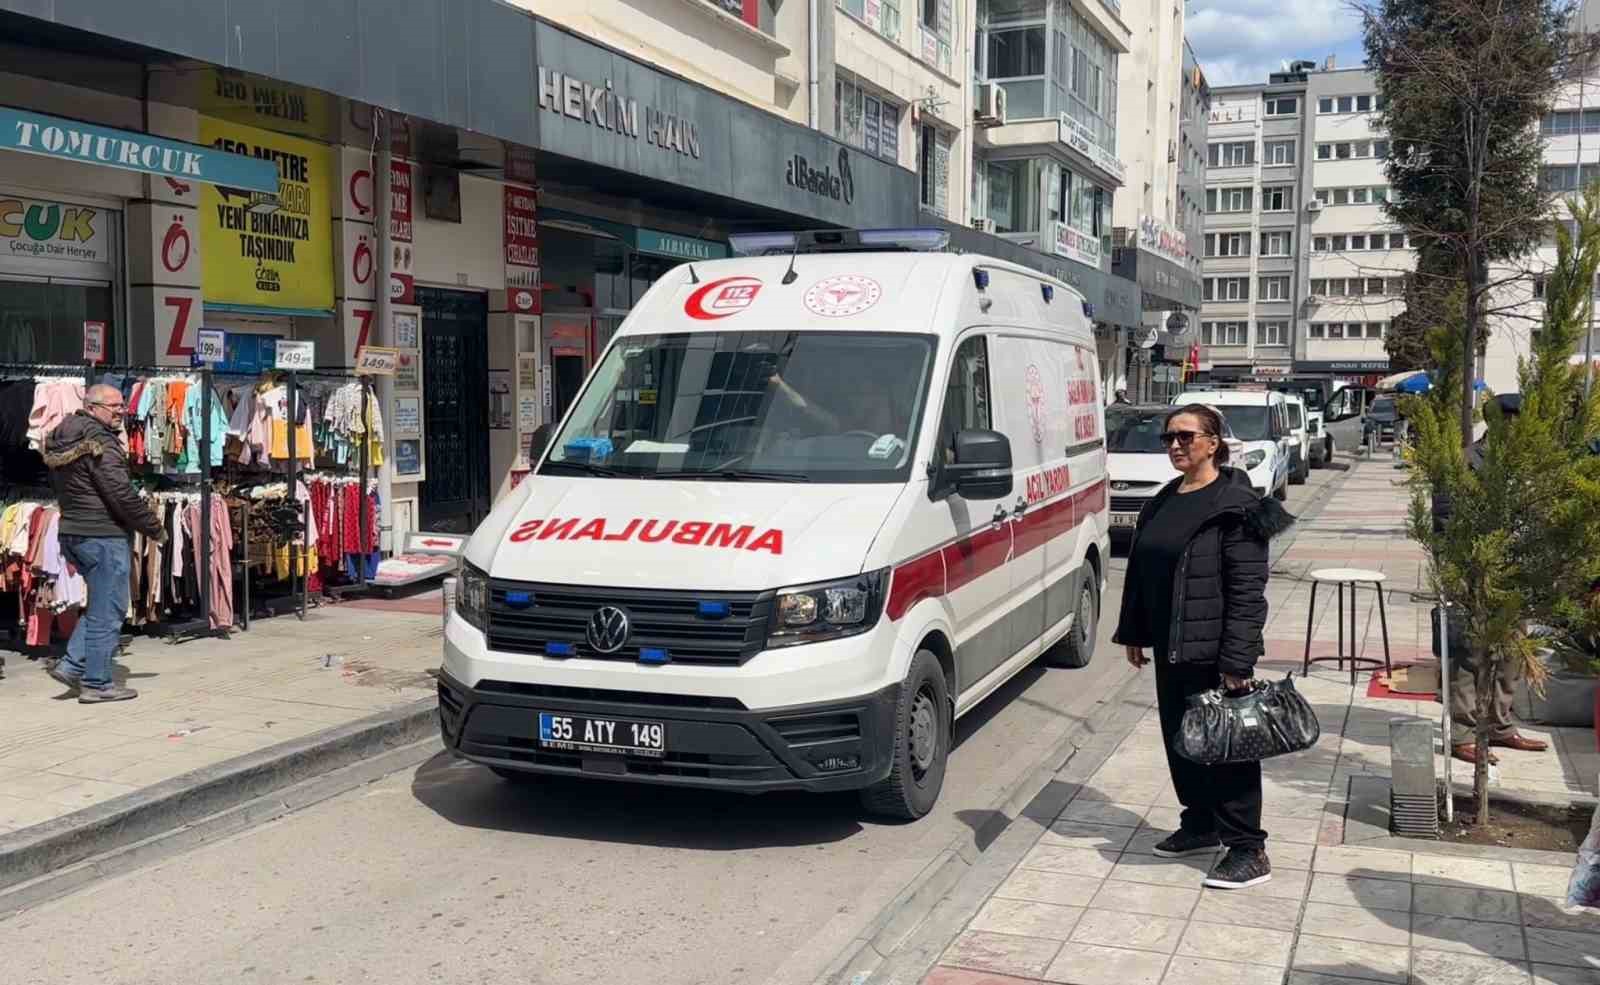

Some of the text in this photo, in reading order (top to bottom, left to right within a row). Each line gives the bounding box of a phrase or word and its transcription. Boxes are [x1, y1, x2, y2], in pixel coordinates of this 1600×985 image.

[537, 65, 701, 160] HEKİM HAN
[16, 121, 201, 176] TOMURCUK
[785, 154, 840, 201] alBaraka
[47, 244, 65, 255] Dair
[724, 287, 752, 298] 112
[551, 715, 574, 738] 55
[584, 719, 616, 744] ATY
[631, 721, 662, 747] 149
